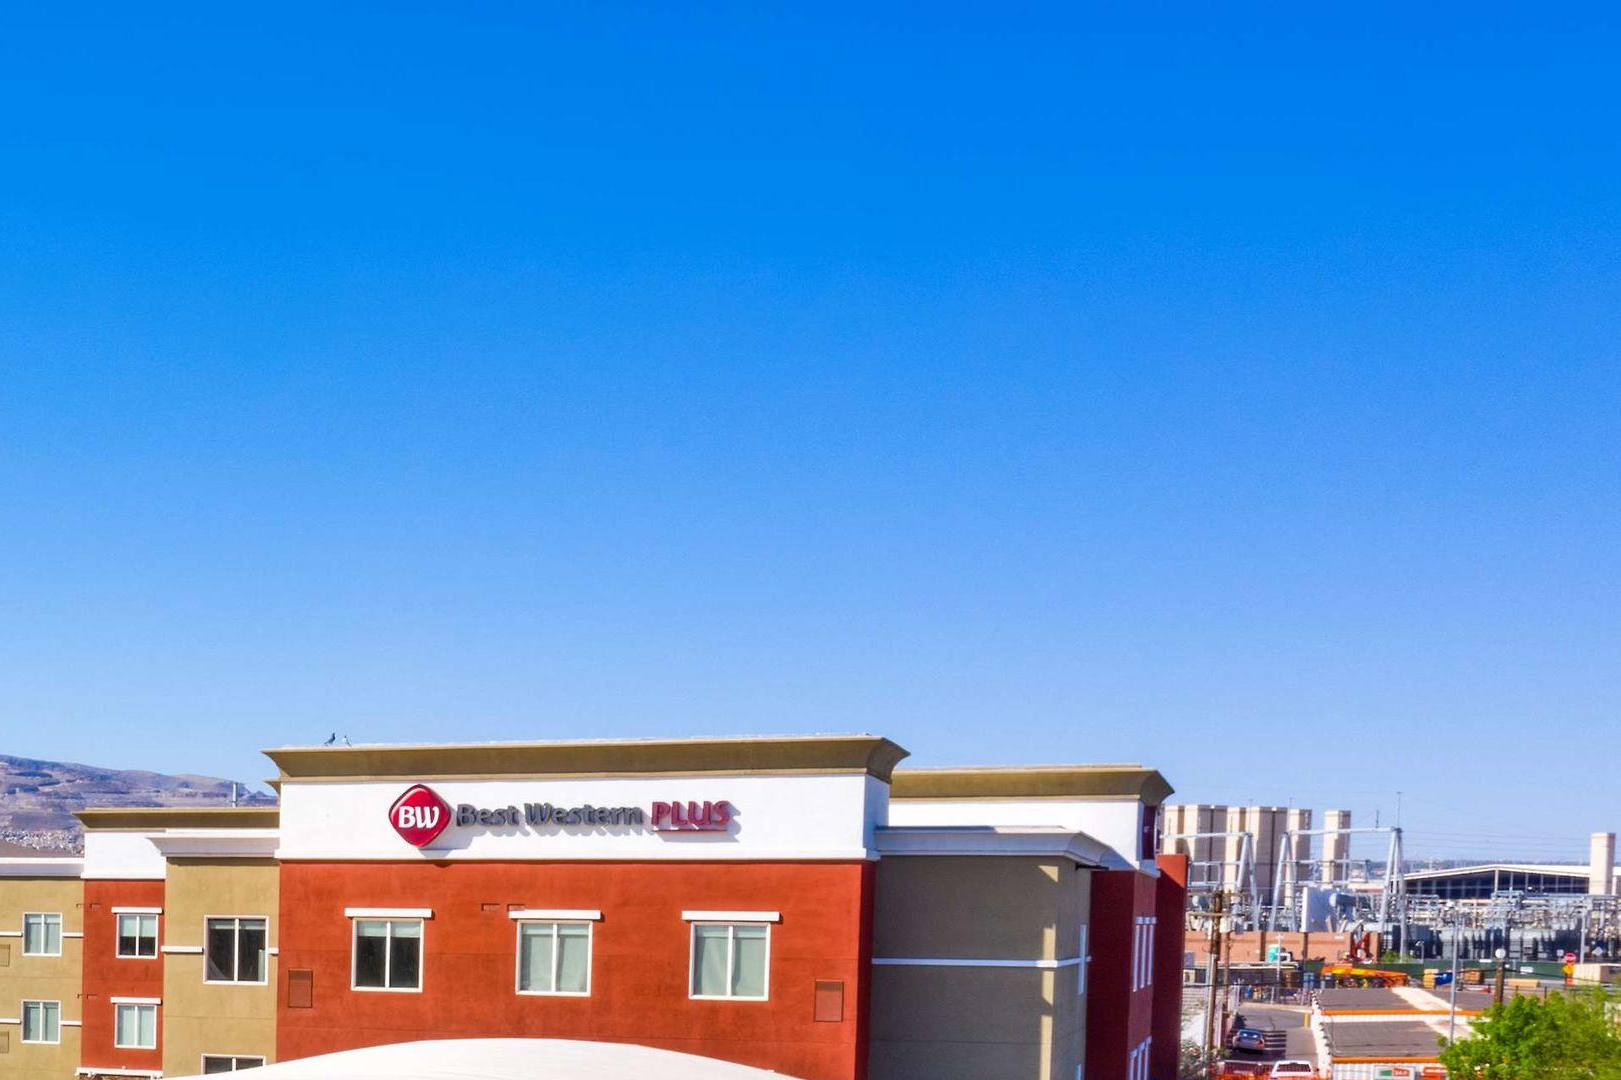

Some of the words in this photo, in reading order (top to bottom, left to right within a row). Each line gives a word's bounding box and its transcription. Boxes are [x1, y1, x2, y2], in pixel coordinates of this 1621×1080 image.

[397, 804, 440, 829] BW
[456, 803, 520, 827] Best
[524, 802, 644, 826] Western
[650, 800, 732, 826] PLUS
